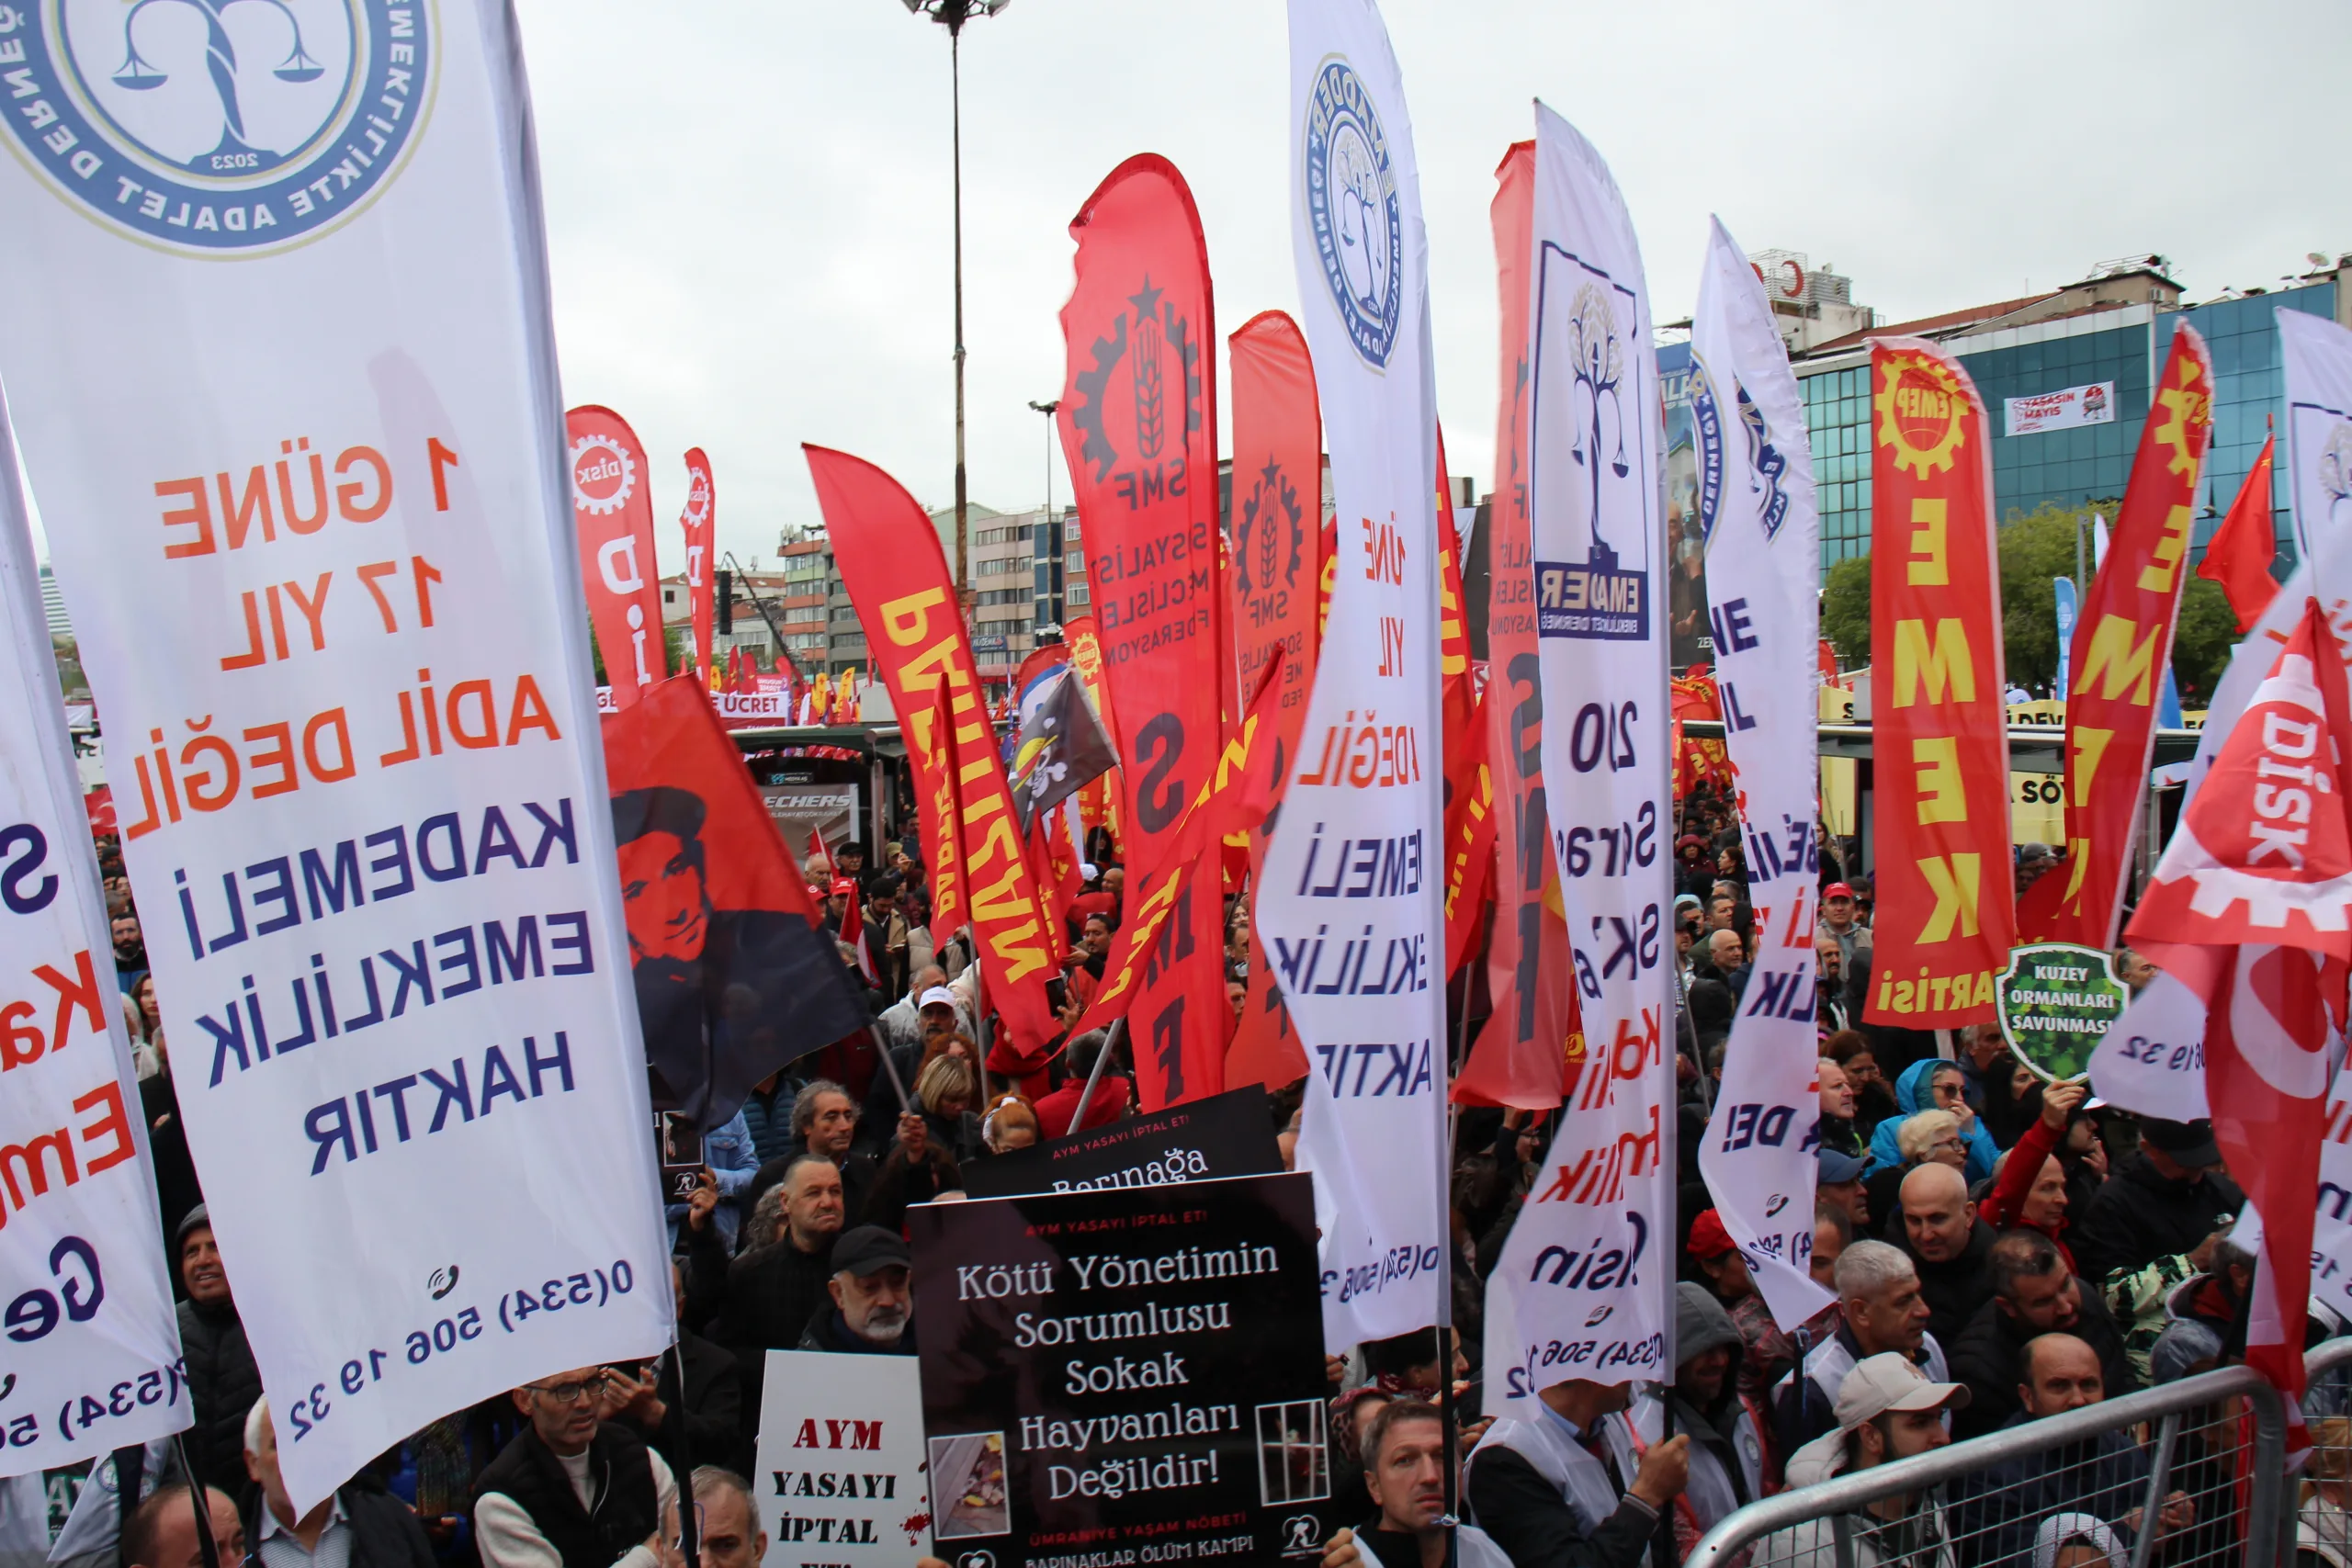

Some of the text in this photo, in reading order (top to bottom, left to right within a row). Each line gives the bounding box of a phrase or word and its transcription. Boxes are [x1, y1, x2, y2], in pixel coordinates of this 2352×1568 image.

[2247, 712, 2332, 872] DİSK
[2034, 965, 2089, 982] KUZEY
[2010, 989, 2114, 1009] ORMANLARI
[1053, 1145, 1080, 1160] AYM
[1084, 1130, 1129, 1152] YASAYI
[1133, 1123, 1168, 1139] İPTAL
[1024, 1224, 1061, 1238] AYM
[1067, 1218, 1126, 1234] YASAYI
[1132, 1212, 1179, 1229] İPTAL
[956, 1242, 1280, 1302] Kötü Yönetimin
[1014, 1302, 1232, 1348] Sorumlusu
[1065, 1351, 1189, 1395] Sokak
[793, 1418, 884, 1450] AYM
[1020, 1403, 1241, 1452] Hayvanları
[772, 1471, 897, 1499] YASAYI
[1049, 1449, 1219, 1500] Değildir!
[778, 1511, 879, 1544] İPTAL
[1029, 1511, 1247, 1547] ÜMRANİYE YAŞAM NÖBETİ
[1139, 1541, 1193, 1563] ÖLÜM
[1198, 1536, 1254, 1556] KAMPI
